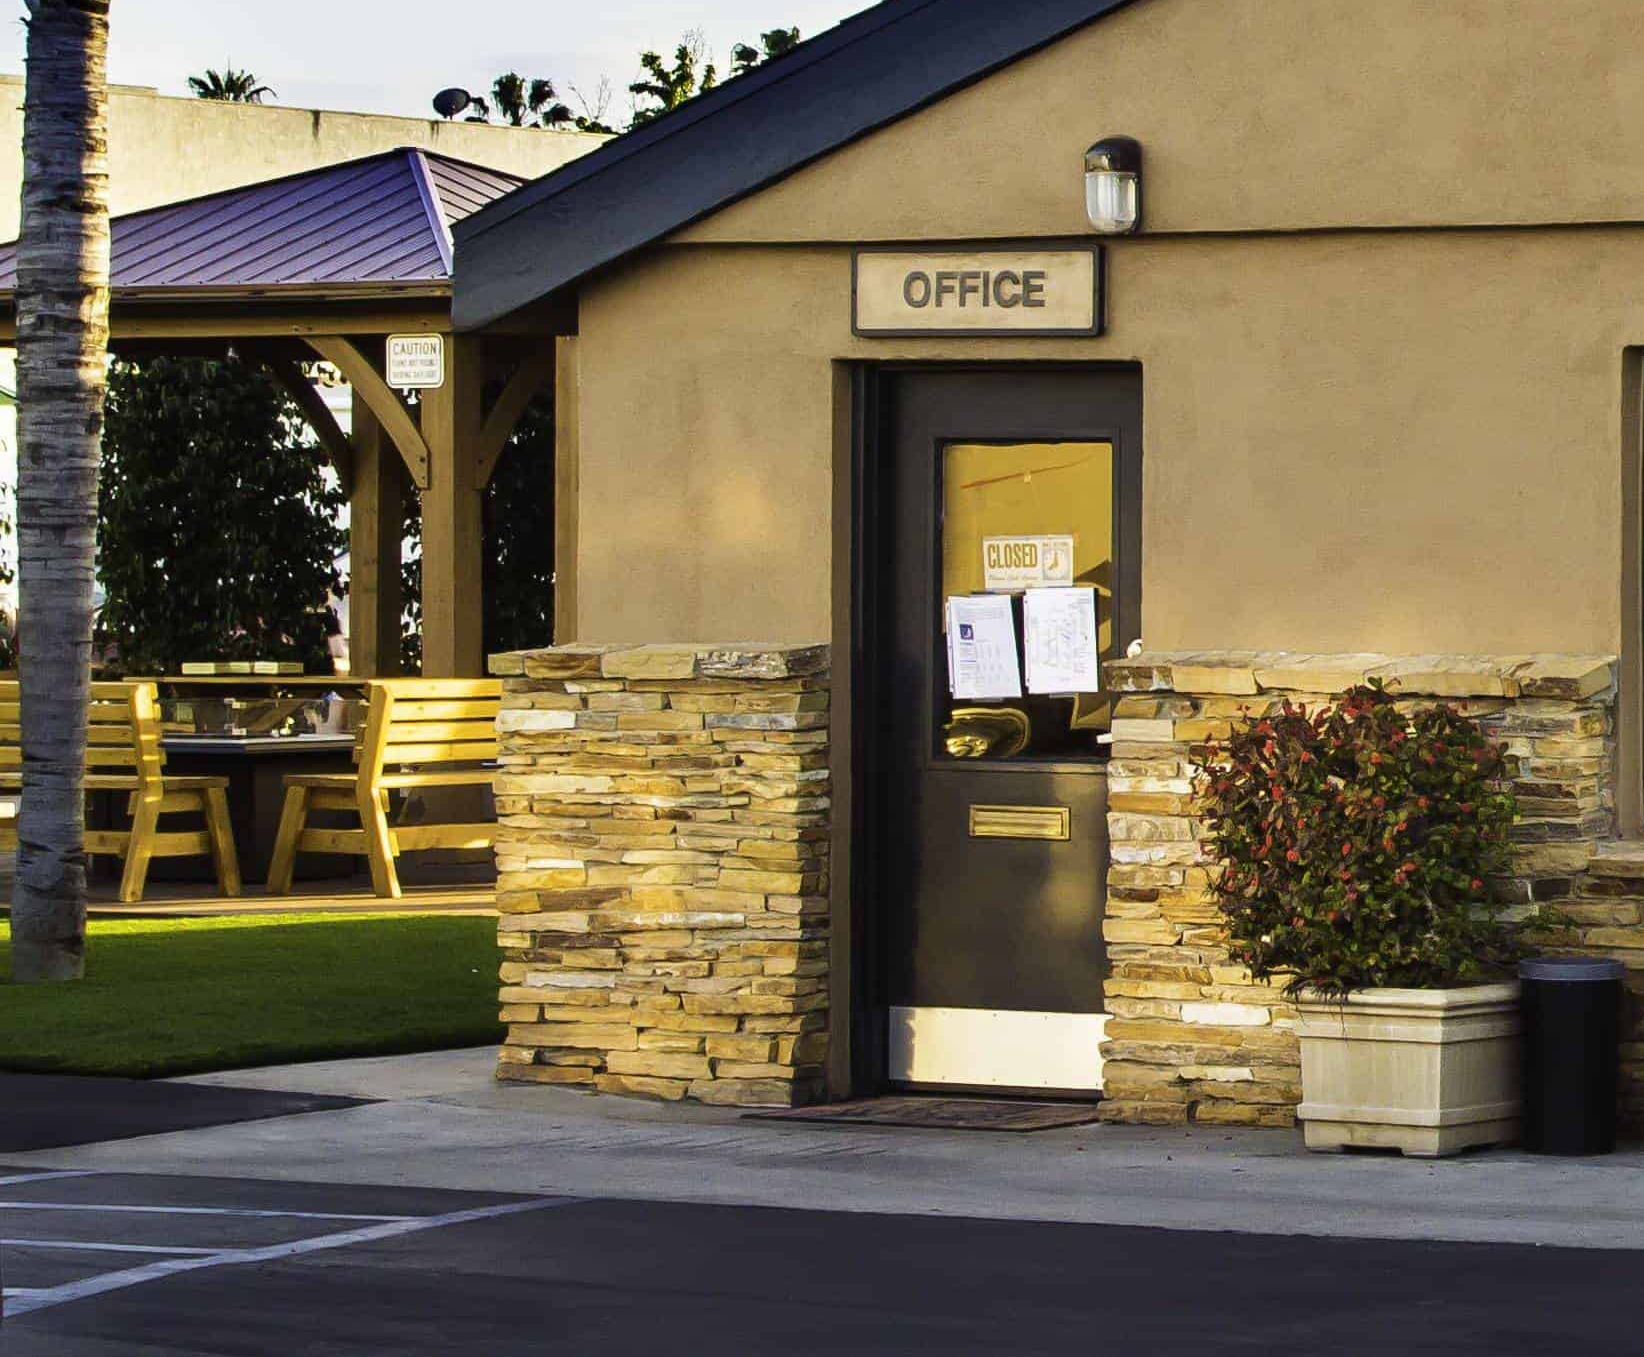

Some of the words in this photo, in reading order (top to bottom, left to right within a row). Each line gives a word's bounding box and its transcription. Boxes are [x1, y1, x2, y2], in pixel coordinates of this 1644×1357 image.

[903, 270, 1046, 308] OFFICE
[392, 342, 437, 355] CAUTION
[987, 543, 1038, 569] CLOSED
